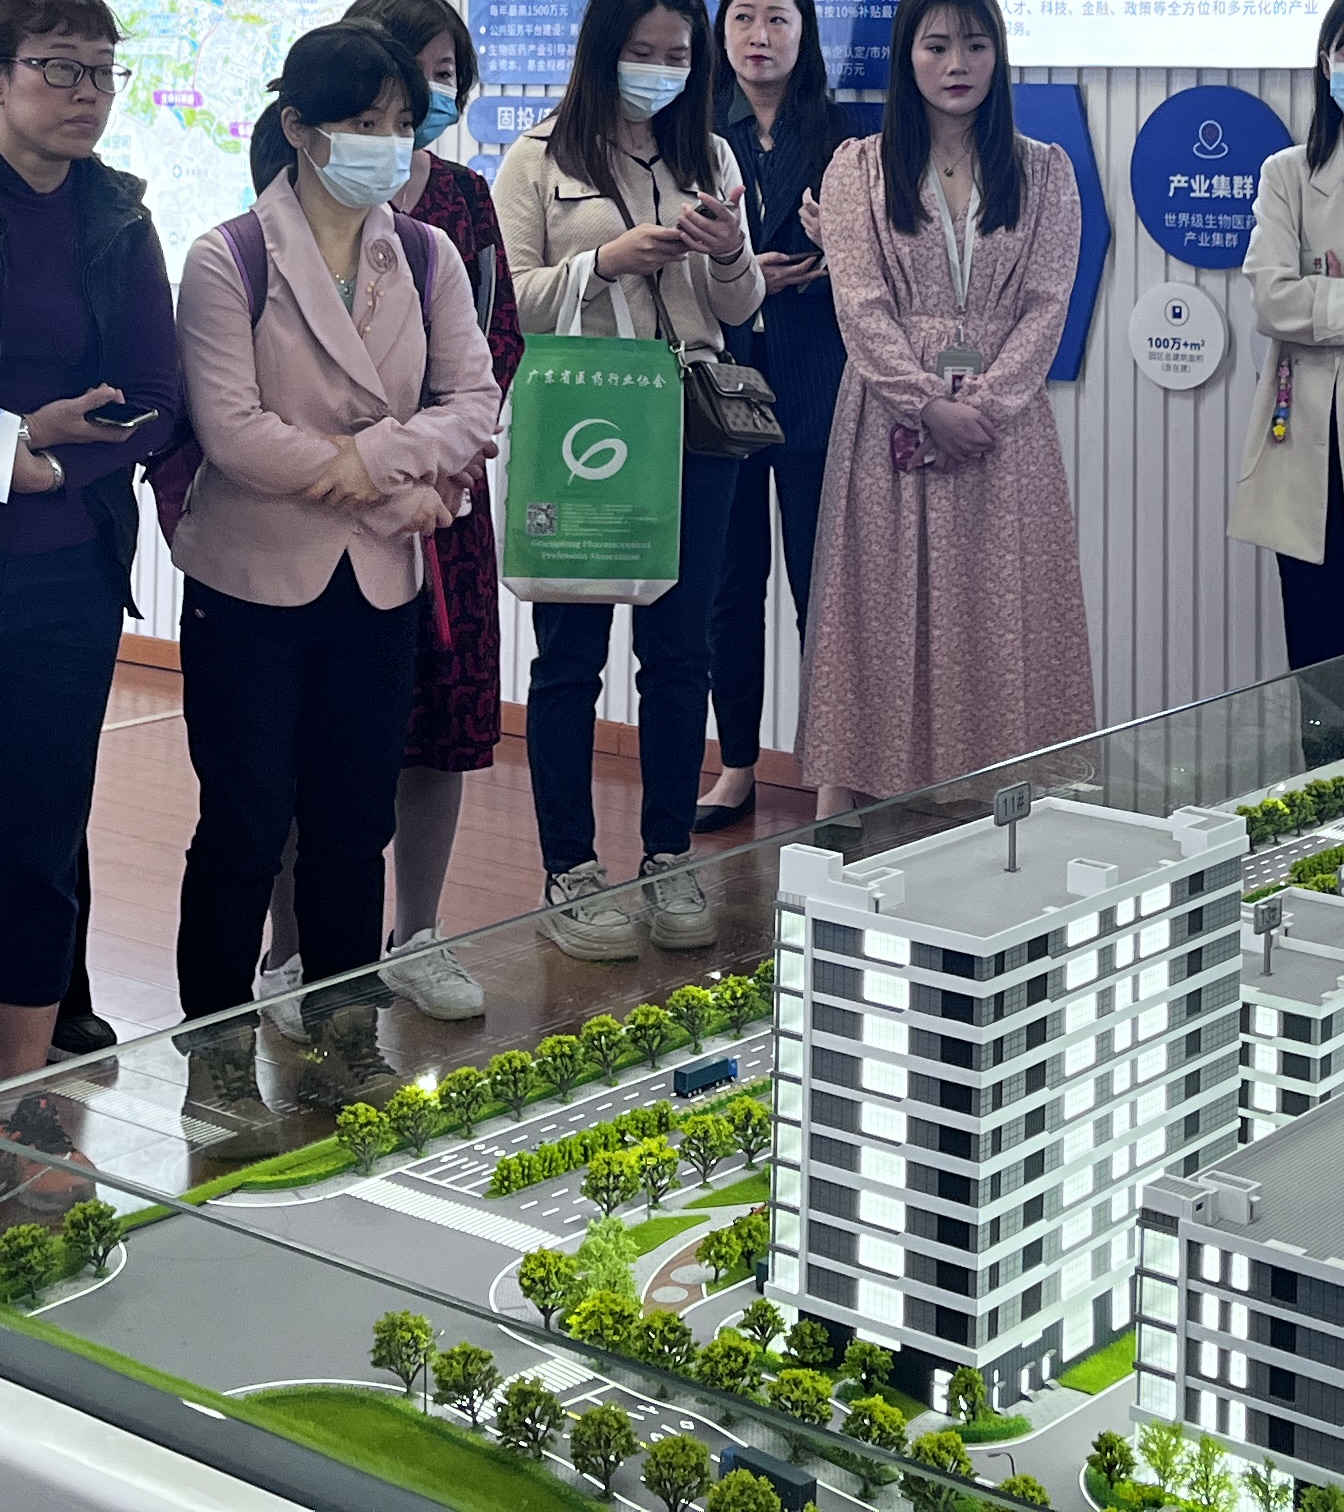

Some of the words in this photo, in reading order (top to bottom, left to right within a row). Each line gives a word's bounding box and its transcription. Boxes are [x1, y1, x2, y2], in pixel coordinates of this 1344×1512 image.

[1003, 0, 1319, 17] 人才、科技、金融、政策等全方位和多元化的产业
[1168, 174, 1254, 199] 产业集群
[1164, 213, 1258, 230] 世界级生物医药
[1183, 232, 1239, 248] 产业集群
